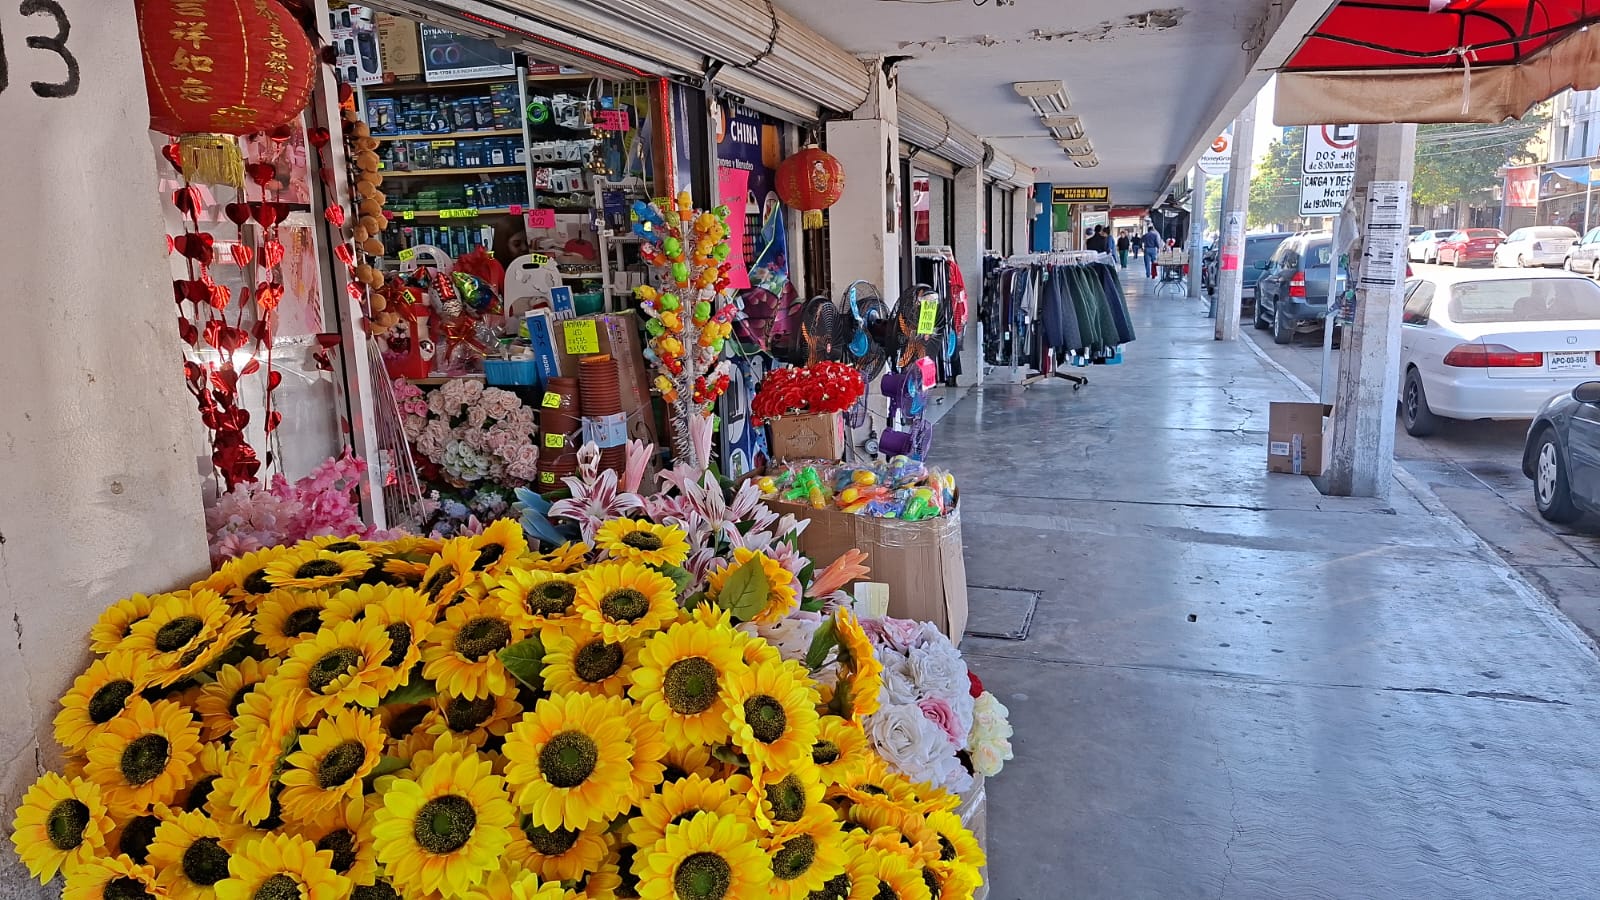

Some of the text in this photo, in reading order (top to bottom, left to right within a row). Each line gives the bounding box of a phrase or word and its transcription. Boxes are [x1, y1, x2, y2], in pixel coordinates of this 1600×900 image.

[0, 0, 80, 98] 3
[730, 121, 759, 145] CHINA
[1316, 151, 1355, 161] DOS HO
[1304, 176, 1328, 187] CARGA
[1329, 176, 1334, 186] Y
